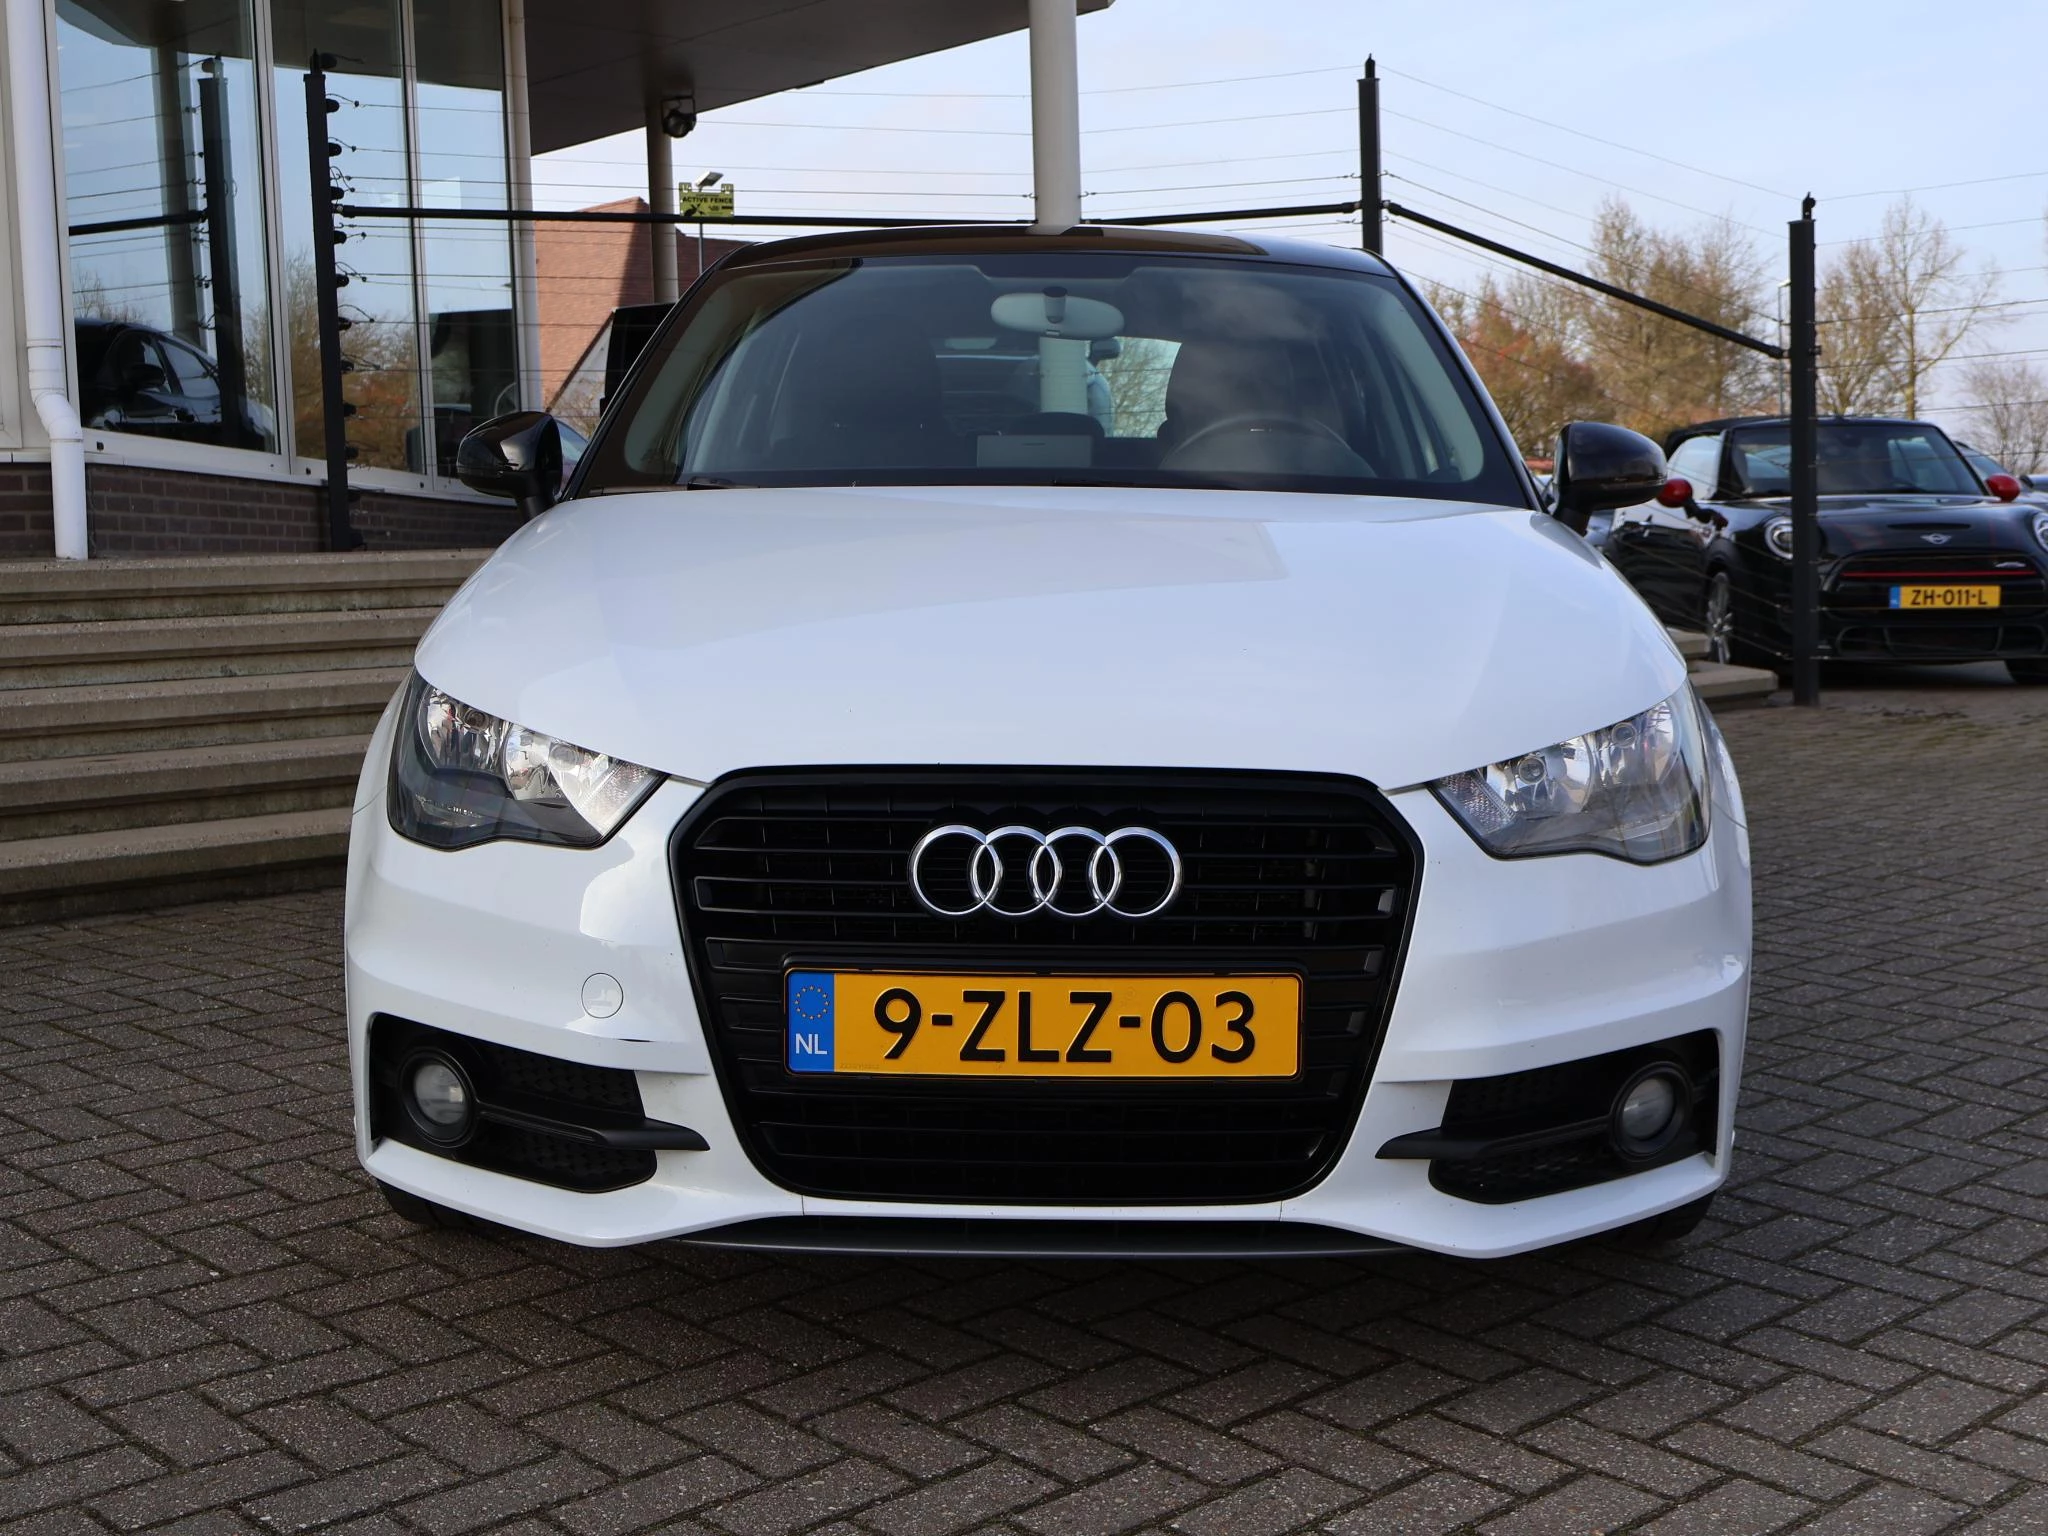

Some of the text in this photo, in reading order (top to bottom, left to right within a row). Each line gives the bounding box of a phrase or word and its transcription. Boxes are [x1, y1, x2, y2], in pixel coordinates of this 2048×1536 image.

[1911, 589, 1988, 605] ZH-011-L
[873, 987, 1256, 1063] 9-ZLZ-03
[795, 1033, 828, 1055] NL
